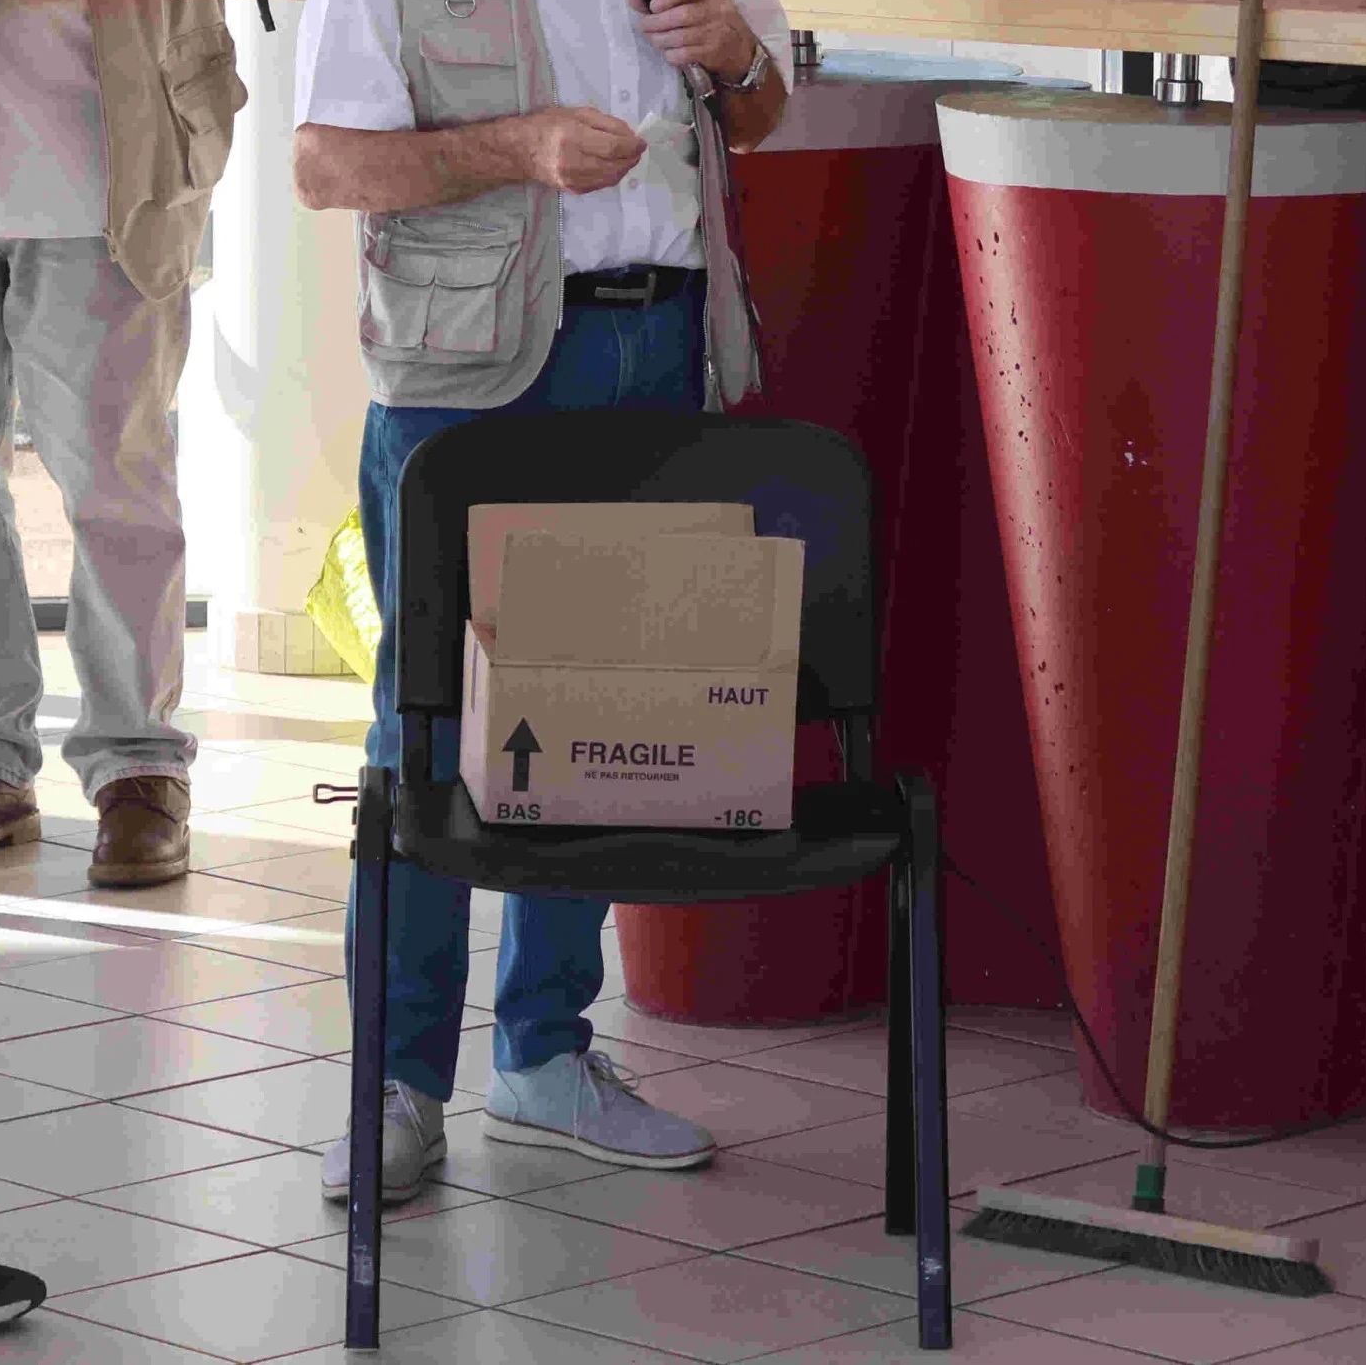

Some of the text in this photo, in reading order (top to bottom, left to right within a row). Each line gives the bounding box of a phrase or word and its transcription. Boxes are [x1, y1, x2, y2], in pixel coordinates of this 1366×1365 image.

[707, 686, 769, 705] HAUT
[570, 741, 696, 767] FRAGILE
[584, 771, 680, 782] NE PAS RETOURNER
[497, 803, 541, 820] BAS
[714, 809, 763, 827] -18C
